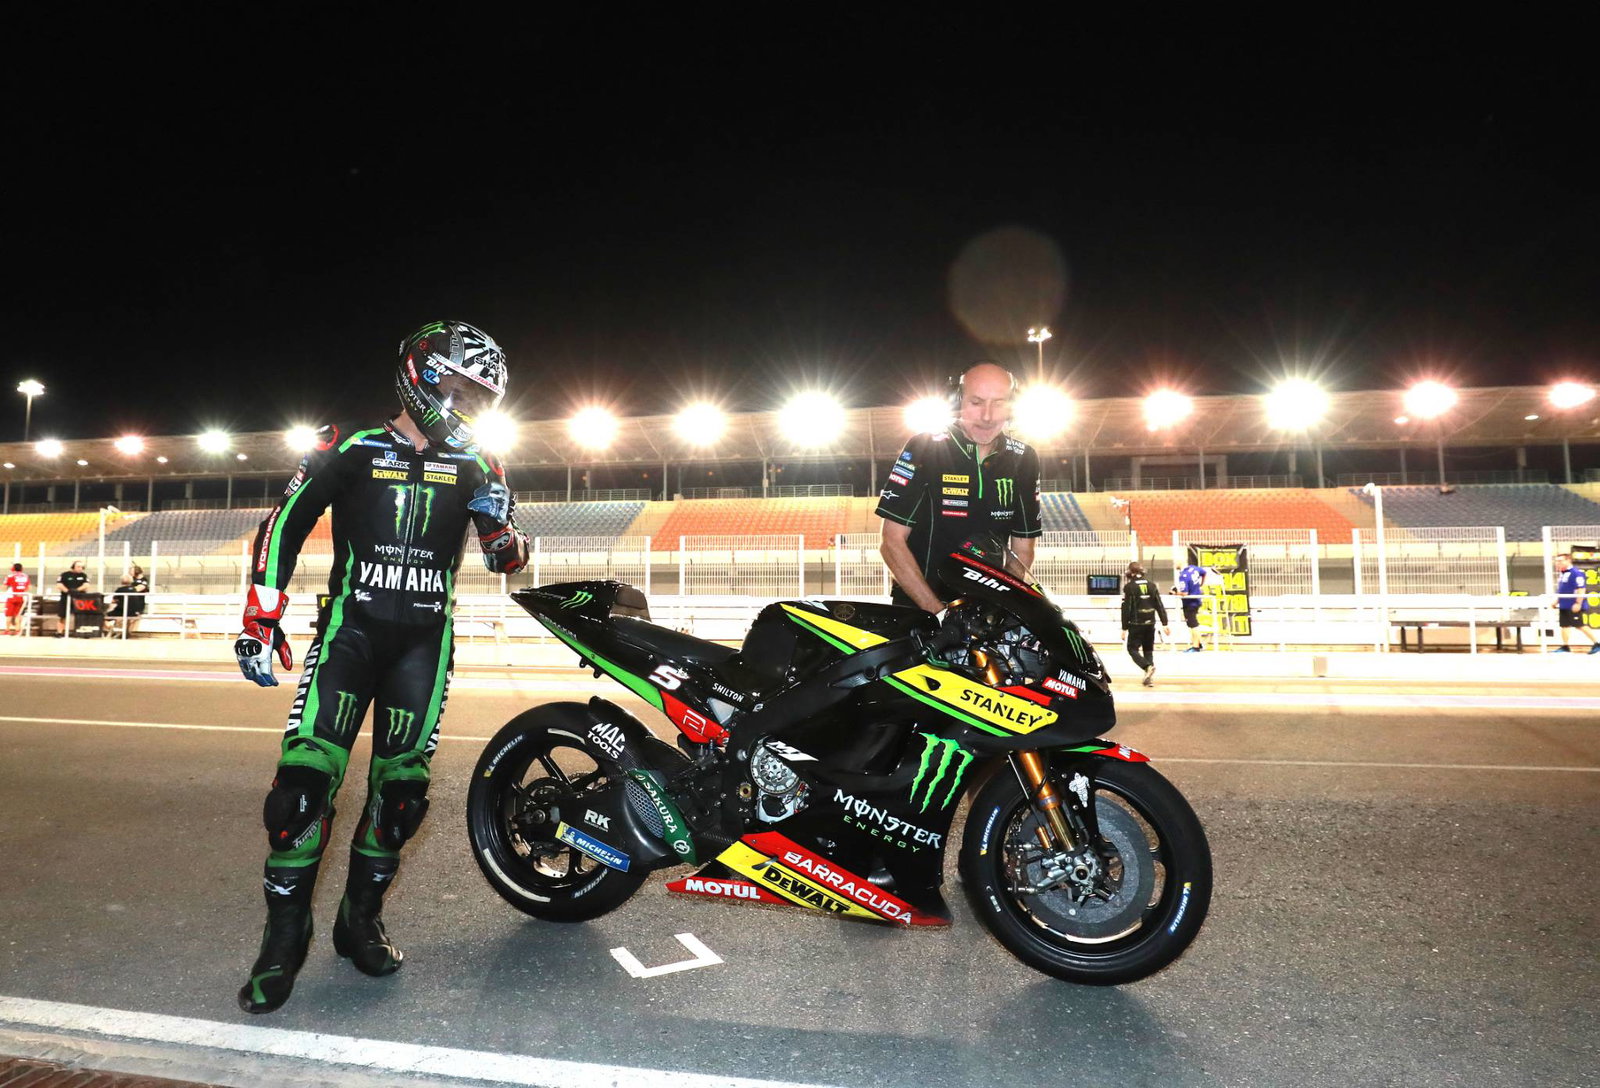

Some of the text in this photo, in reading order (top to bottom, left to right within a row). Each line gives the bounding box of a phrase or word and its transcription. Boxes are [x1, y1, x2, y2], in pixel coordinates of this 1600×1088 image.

[426, 474, 456, 483] STANLEY
[374, 544, 434, 560] MONTER
[1202, 552, 1238, 567] BOX
[359, 561, 445, 592] YAMAHA
[963, 566, 1011, 592] Bihr
[712, 682, 744, 703] SHILTON
[1045, 679, 1077, 698] MOTUL
[1058, 669, 1087, 691] YAMAHA
[960, 689, 1042, 728] STANLEY
[493, 734, 524, 765] MICHELIN
[587, 731, 619, 759] TOOLS
[591, 722, 626, 752] MAC
[584, 809, 611, 829] RK
[643, 782, 678, 834] SAKURA
[833, 788, 942, 849] MONSTER
[843, 815, 920, 853] ENERGY
[577, 838, 622, 865] MICHELIN
[685, 878, 761, 900] MOTUL
[783, 851, 913, 925] BARRACUDA
